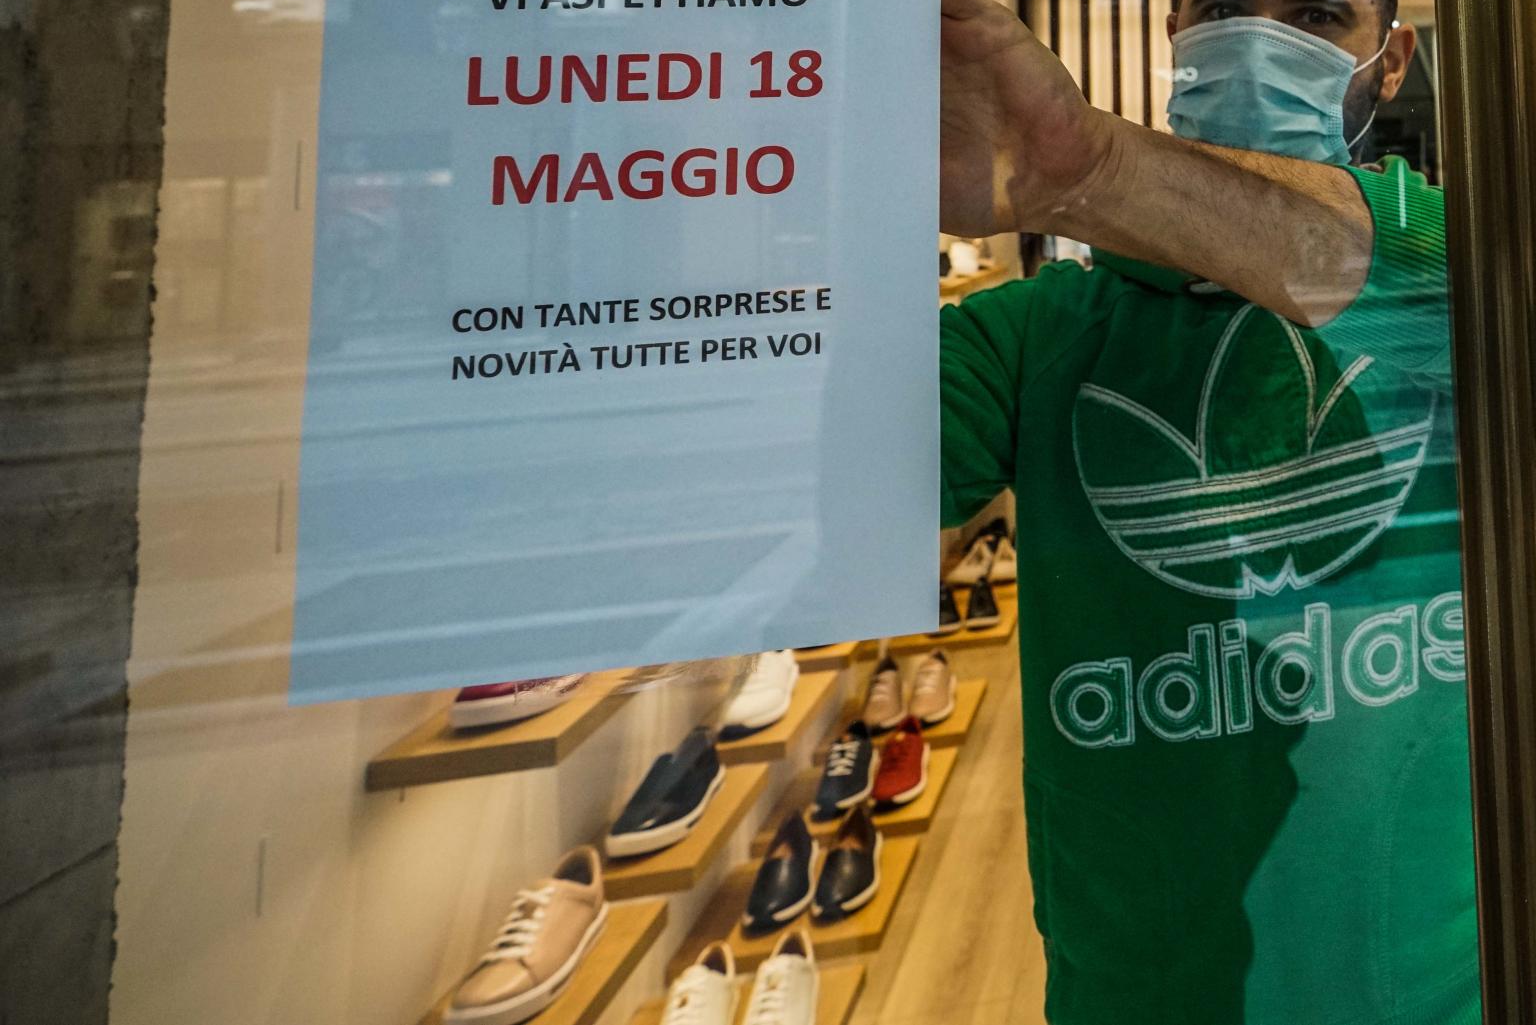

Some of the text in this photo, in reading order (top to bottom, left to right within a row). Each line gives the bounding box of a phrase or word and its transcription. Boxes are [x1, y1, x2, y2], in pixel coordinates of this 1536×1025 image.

[466, 48, 825, 107] LUNEDI 18
[490, 144, 796, 207] MAGGIO
[451, 286, 833, 334] CON TANTE SORPRESE E
[451, 331, 822, 382] NOVITÀ TUTTE PER VOI
[1049, 590, 1467, 748] adidas
